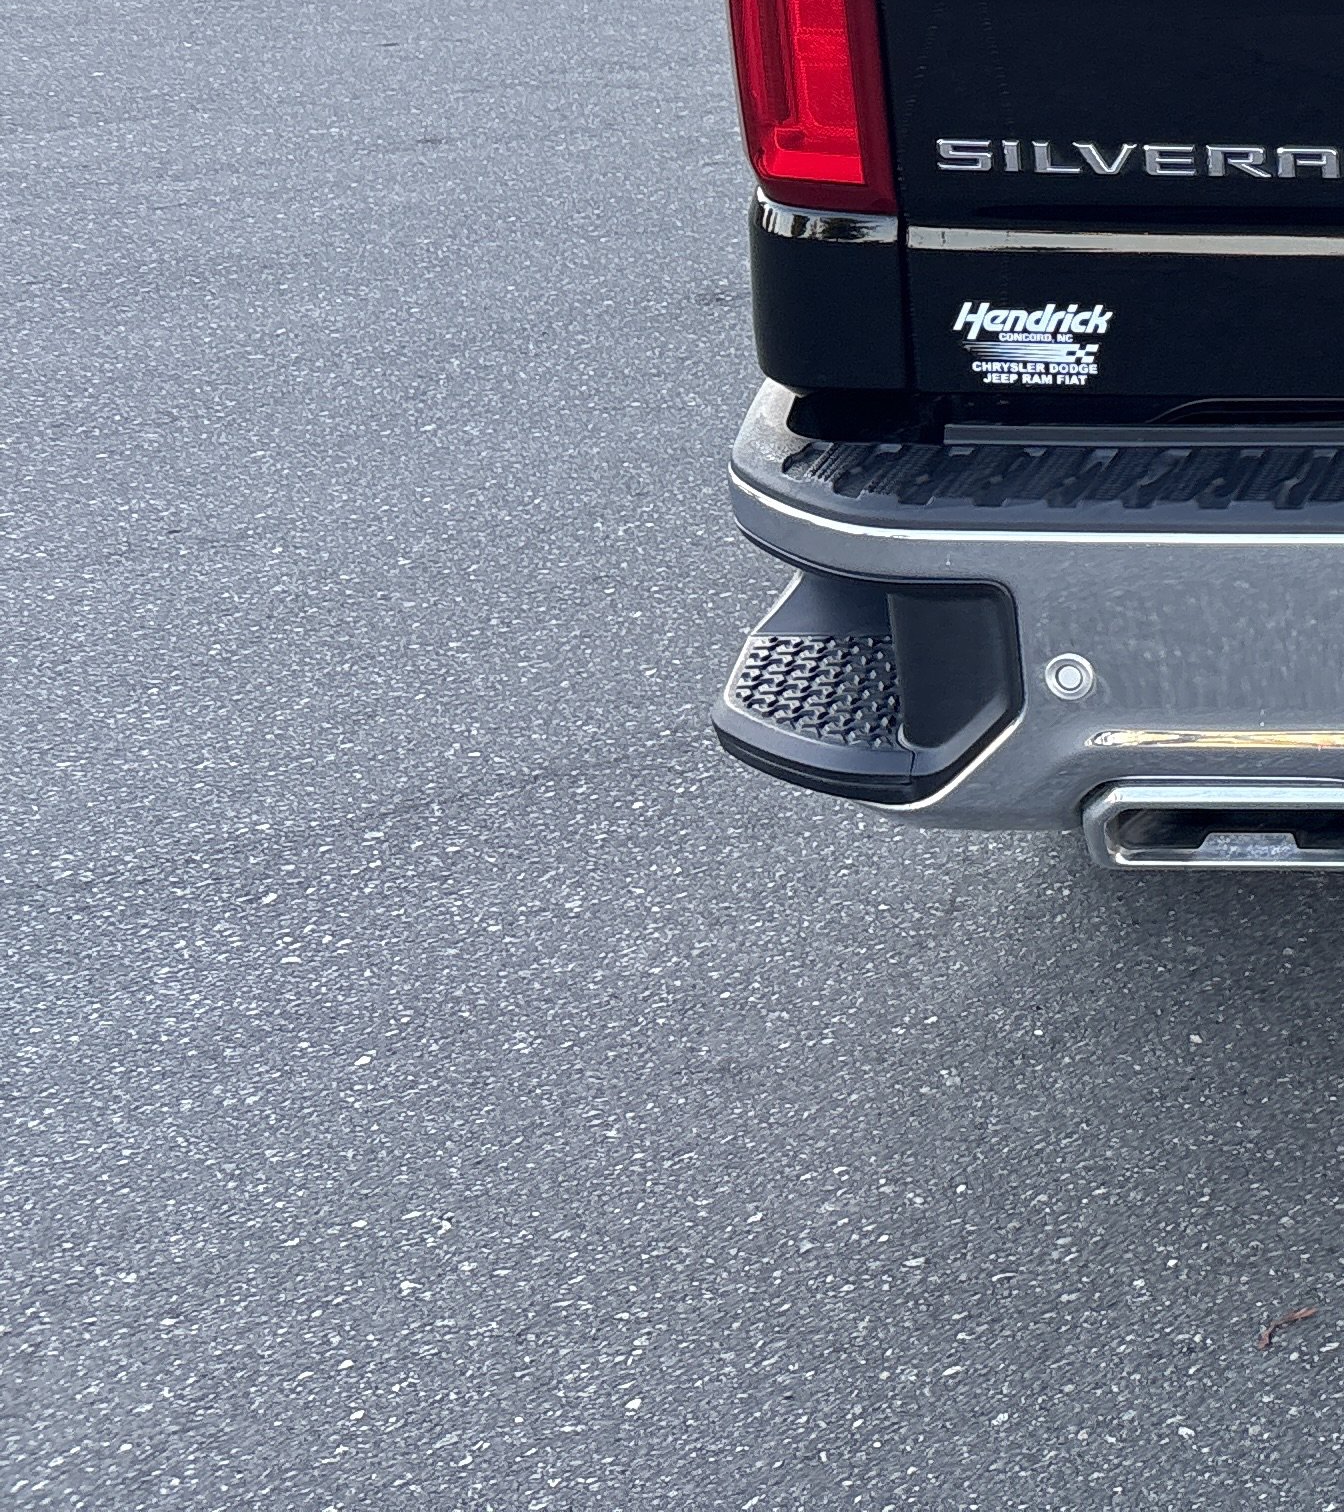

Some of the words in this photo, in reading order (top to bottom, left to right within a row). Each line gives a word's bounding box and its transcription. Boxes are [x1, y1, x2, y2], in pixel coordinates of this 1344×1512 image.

[953, 302, 1113, 340] Hendrick
[999, 332, 1055, 343] CONCORD,
[1057, 333, 1073, 343] NC
[972, 361, 1045, 372] CHRYSLER
[1049, 363, 1098, 374] DODGE
[983, 373, 1017, 384] JEEP
[1022, 374, 1052, 384] RAM
[1057, 375, 1087, 385] FIAT
